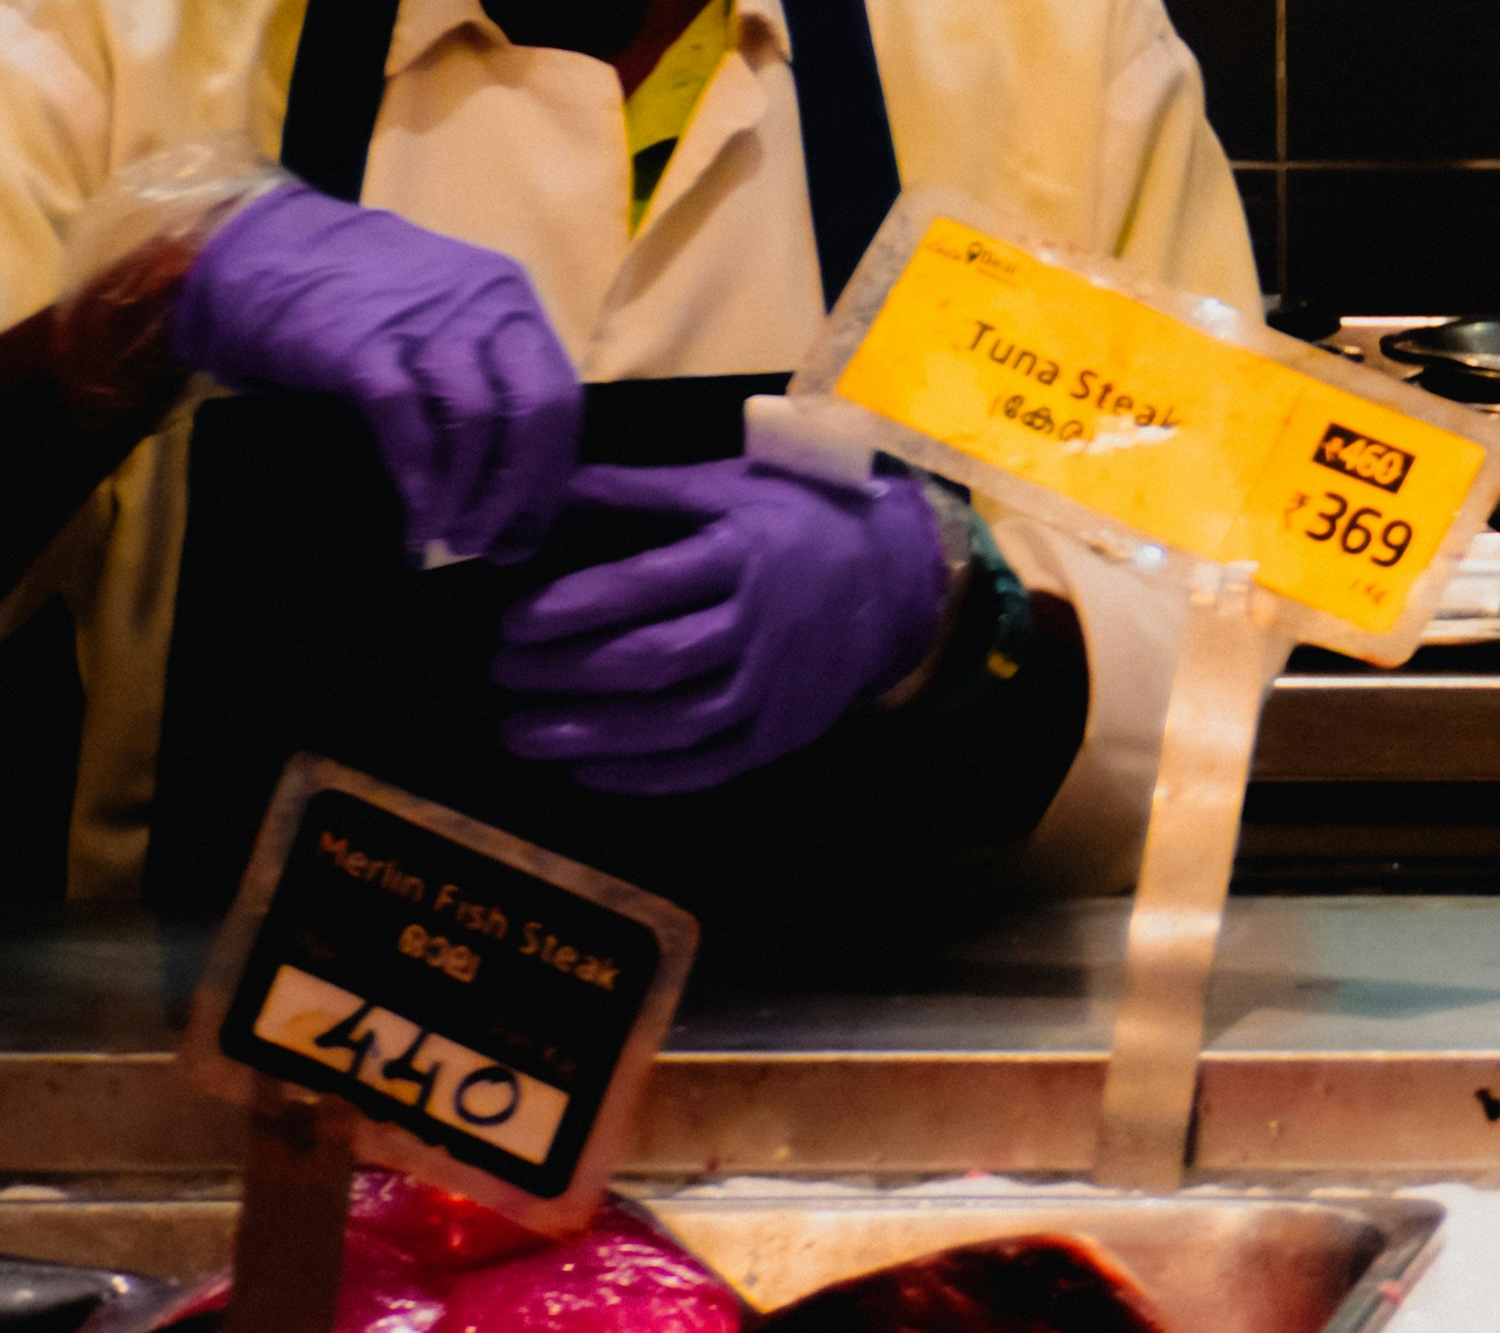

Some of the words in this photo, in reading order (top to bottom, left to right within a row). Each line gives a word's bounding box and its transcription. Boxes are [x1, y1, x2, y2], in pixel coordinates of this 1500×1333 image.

[968, 321, 1060, 386] Tuna
[432, 883, 510, 942] Fish
[517, 920, 620, 993] Steak
